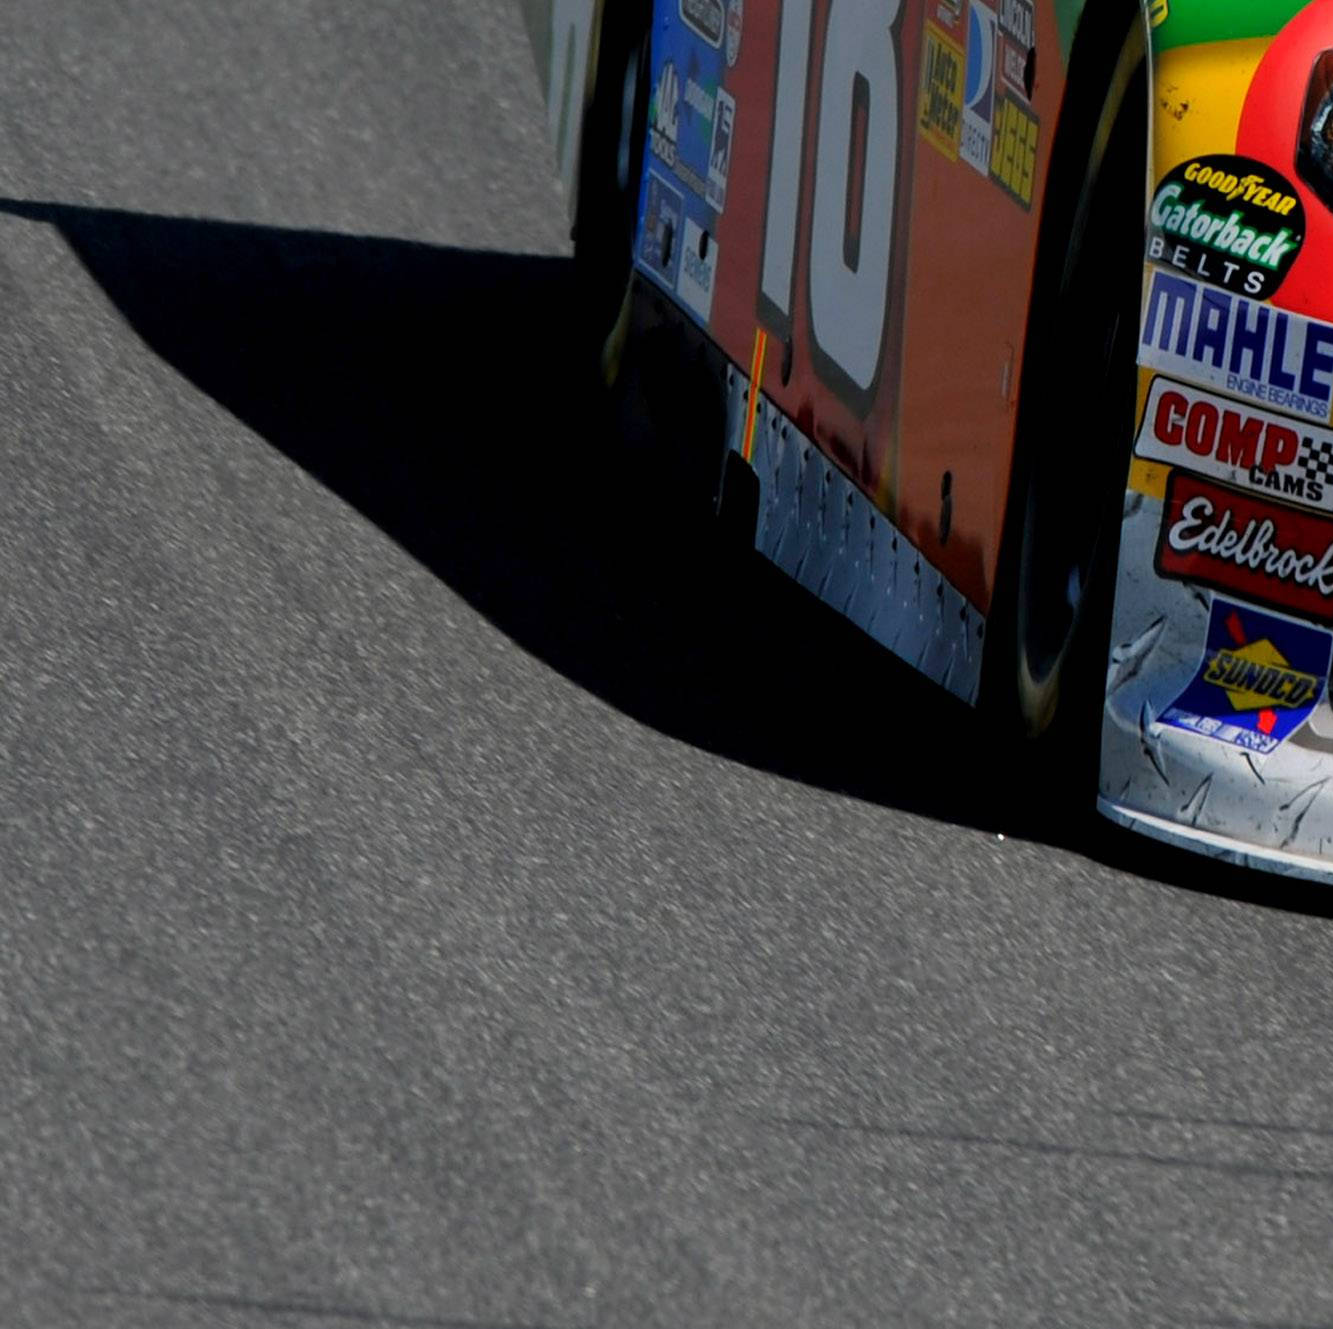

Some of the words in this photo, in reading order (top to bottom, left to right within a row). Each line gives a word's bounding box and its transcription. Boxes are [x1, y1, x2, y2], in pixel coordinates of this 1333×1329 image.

[991, 97, 1039, 206] JEGS
[1184, 162, 1297, 216] GOODYEAR
[1151, 183, 1294, 269] Gatorback
[1149, 236, 1265, 294] BELTS
[1226, 374, 1267, 400] ENGINE
[1268, 387, 1328, 418] BEARINGS
[1153, 390, 1299, 473] COMP
[1249, 465, 1324, 503] CAMS
[1206, 651, 1315, 703] SUNOCO
